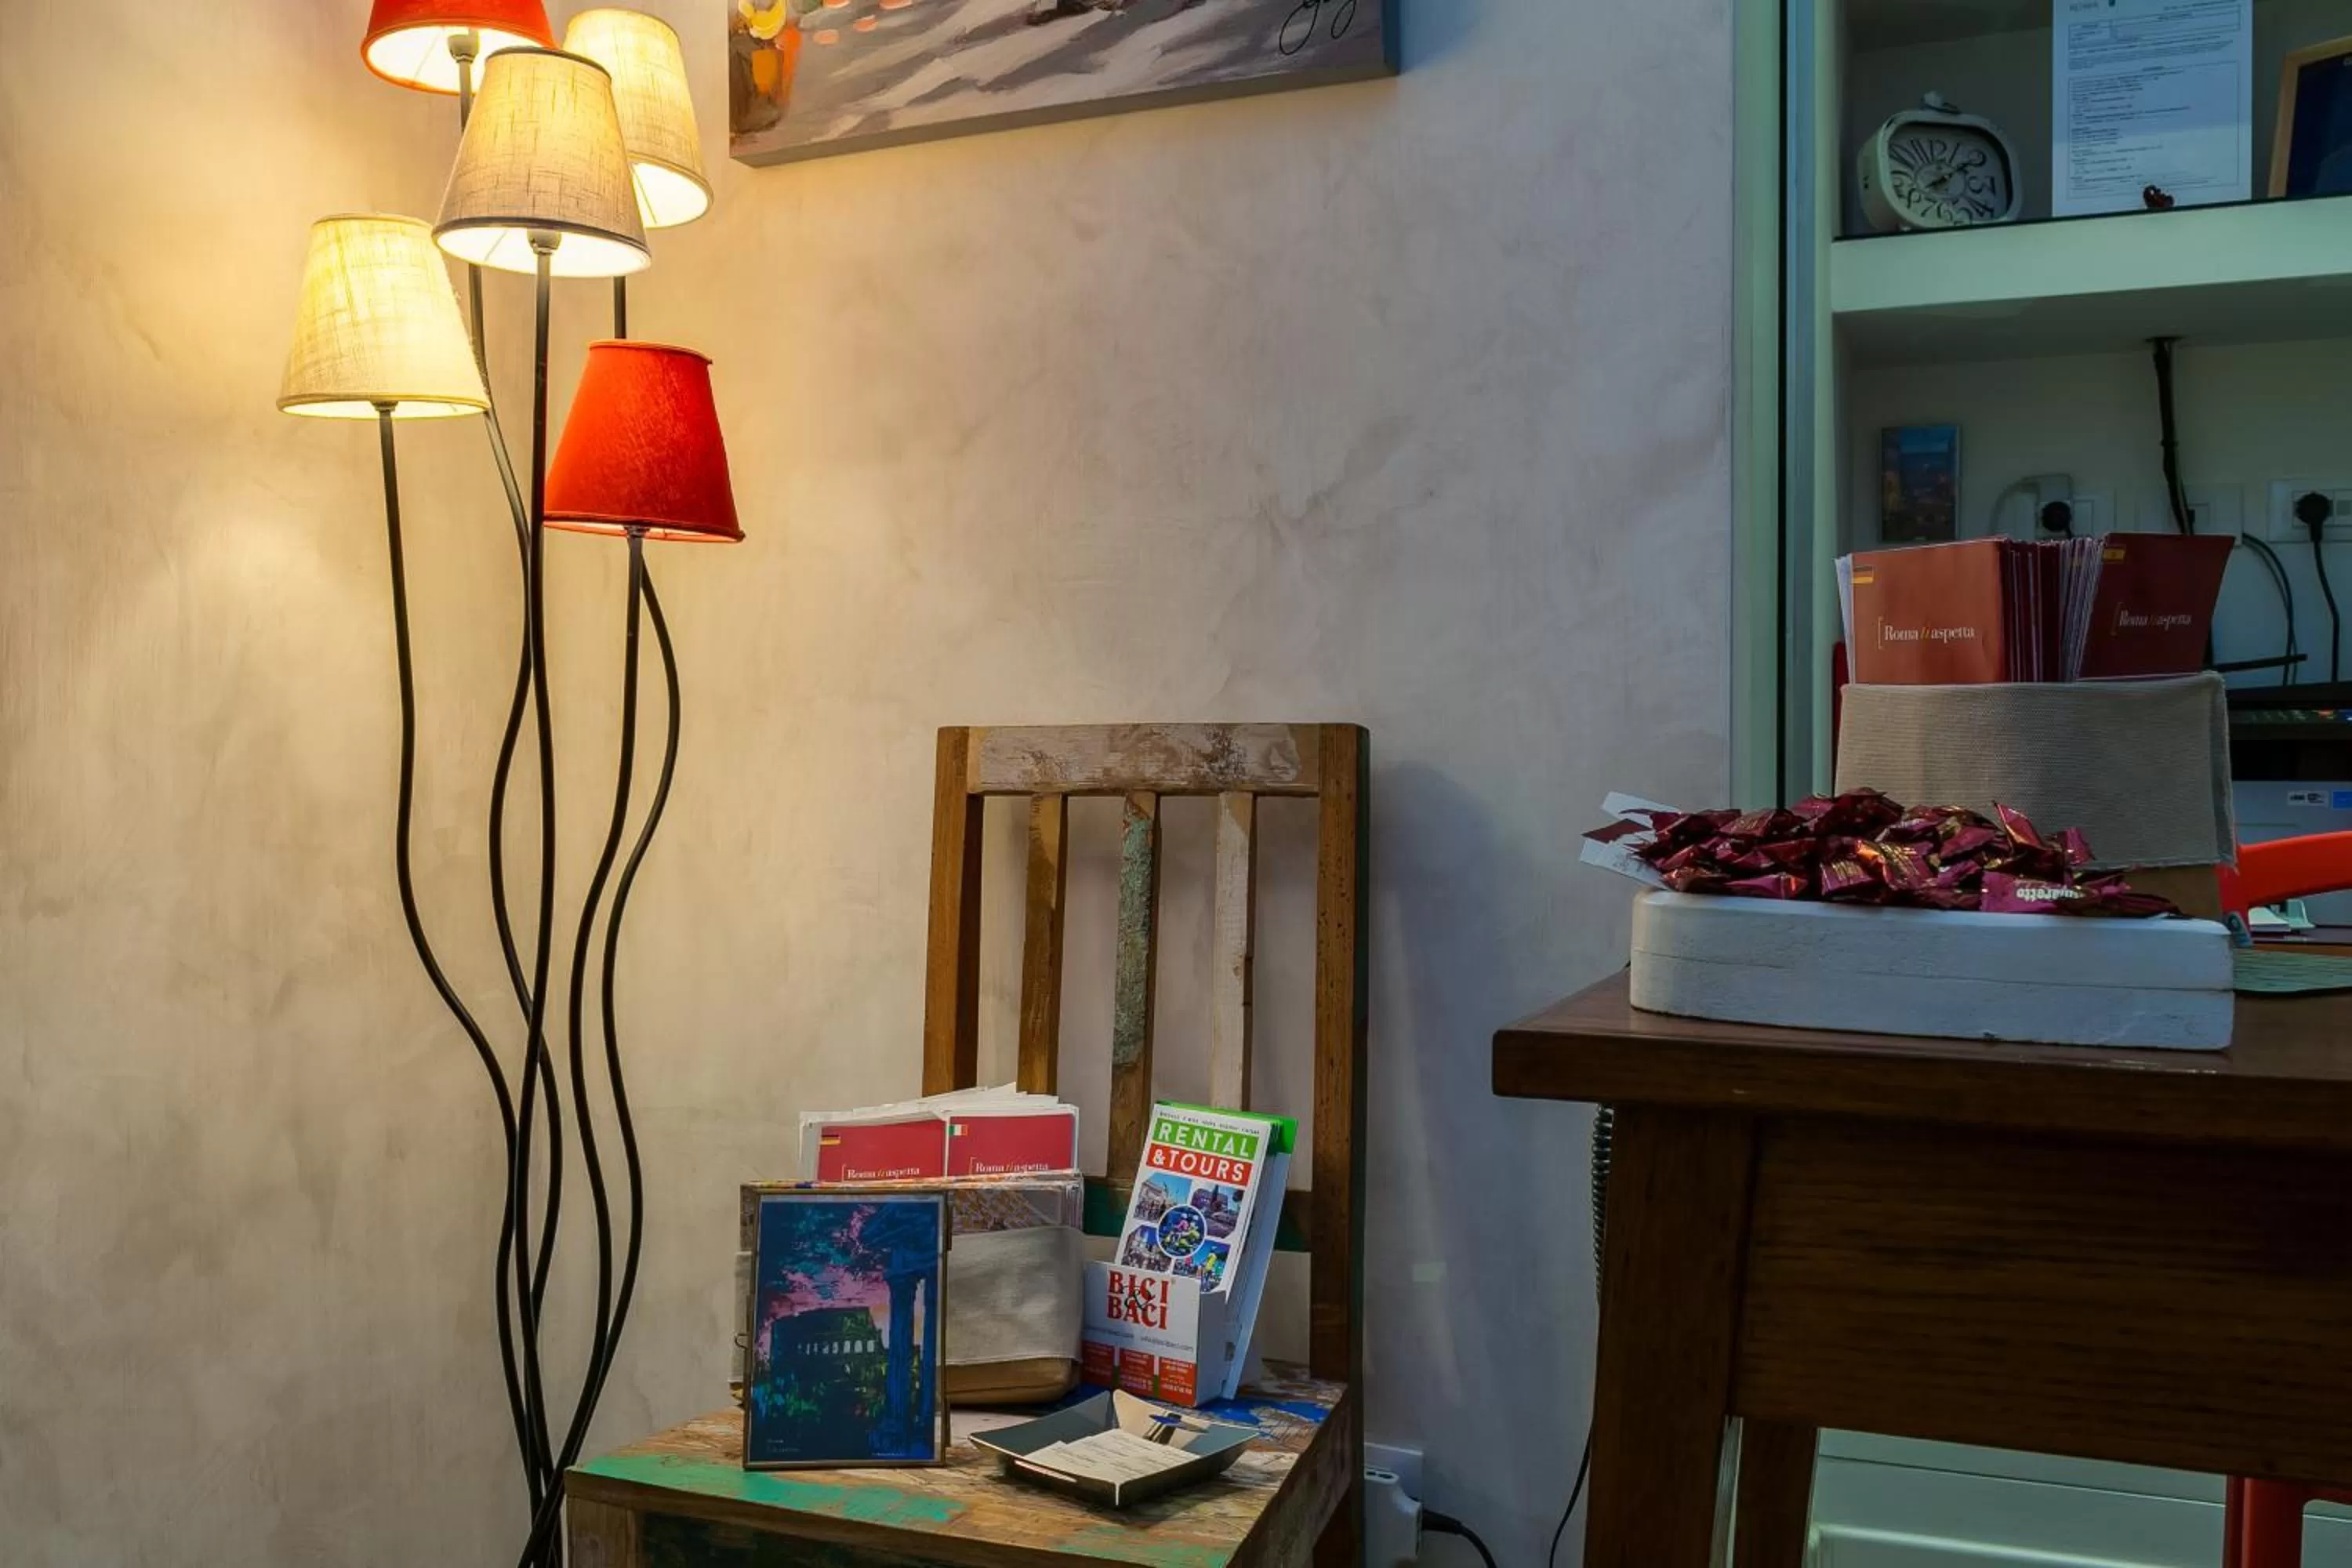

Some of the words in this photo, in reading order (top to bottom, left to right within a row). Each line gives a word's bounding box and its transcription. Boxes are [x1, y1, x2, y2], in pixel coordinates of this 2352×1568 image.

[1969, 175, 1996, 196] 3
[1884, 624, 1918, 641] Roma
[1931, 626, 1976, 644] aspetta
[1157, 1124, 1250, 1158] RENTAL
[847, 1168, 876, 1180] Roma
[885, 1165, 920, 1178] aspetta
[975, 1161, 1005, 1173] Roma
[1014, 1160, 1049, 1173] aspetta
[1152, 1148, 1244, 1181] &TOURS
[1108, 1269, 1170, 1305] BICI
[1106, 1294, 1168, 1330] BACI
